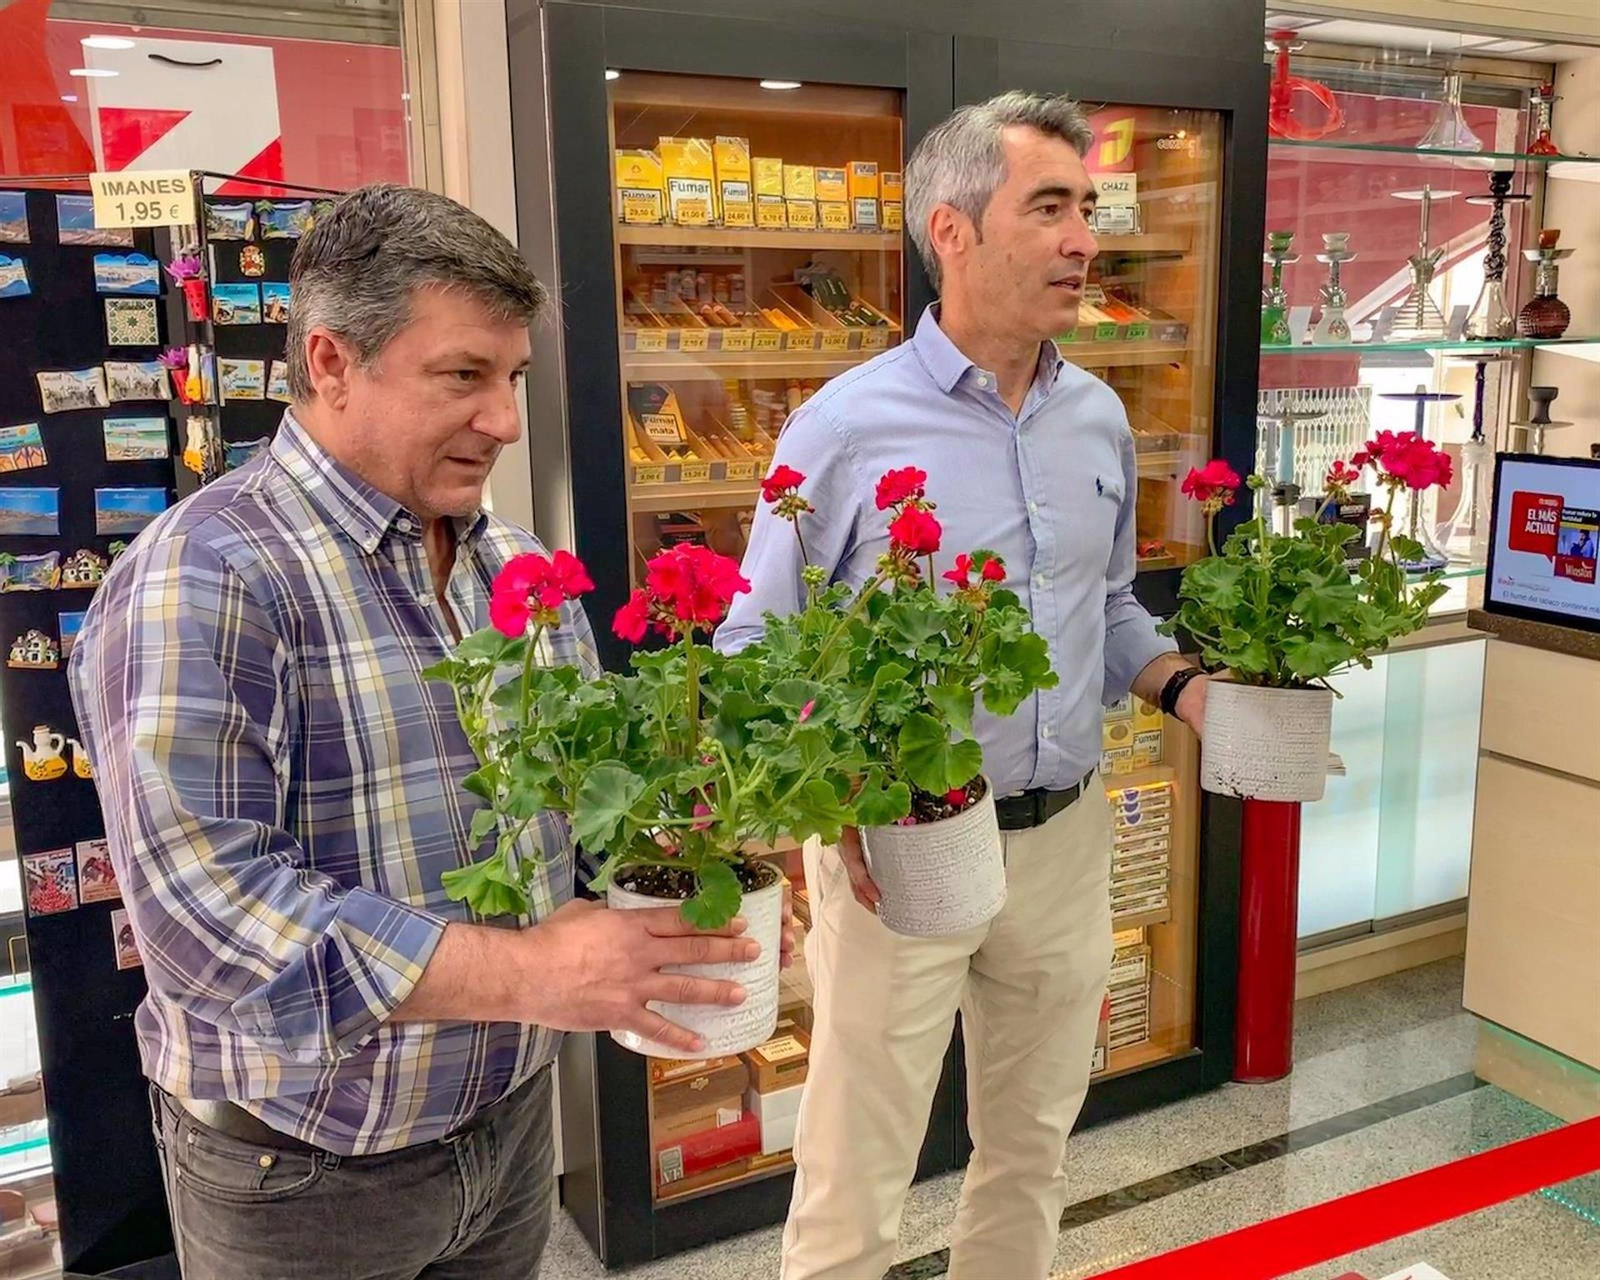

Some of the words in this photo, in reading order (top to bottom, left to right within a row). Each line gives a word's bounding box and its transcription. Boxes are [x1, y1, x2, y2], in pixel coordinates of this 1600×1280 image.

[102, 179, 186, 197] IMANES
[668, 180, 709, 193] Fumar
[723, 188, 747, 197] Fumar
[1101, 182, 1129, 191] CHAZZ
[115, 202, 163, 222] 1,95
[169, 204, 180, 219] €
[1527, 508, 1537, 520] EL
[1525, 521, 1556, 535] ACTUAL
[1133, 733, 1160, 744] Fumar
[1102, 750, 1129, 760] Fumar
